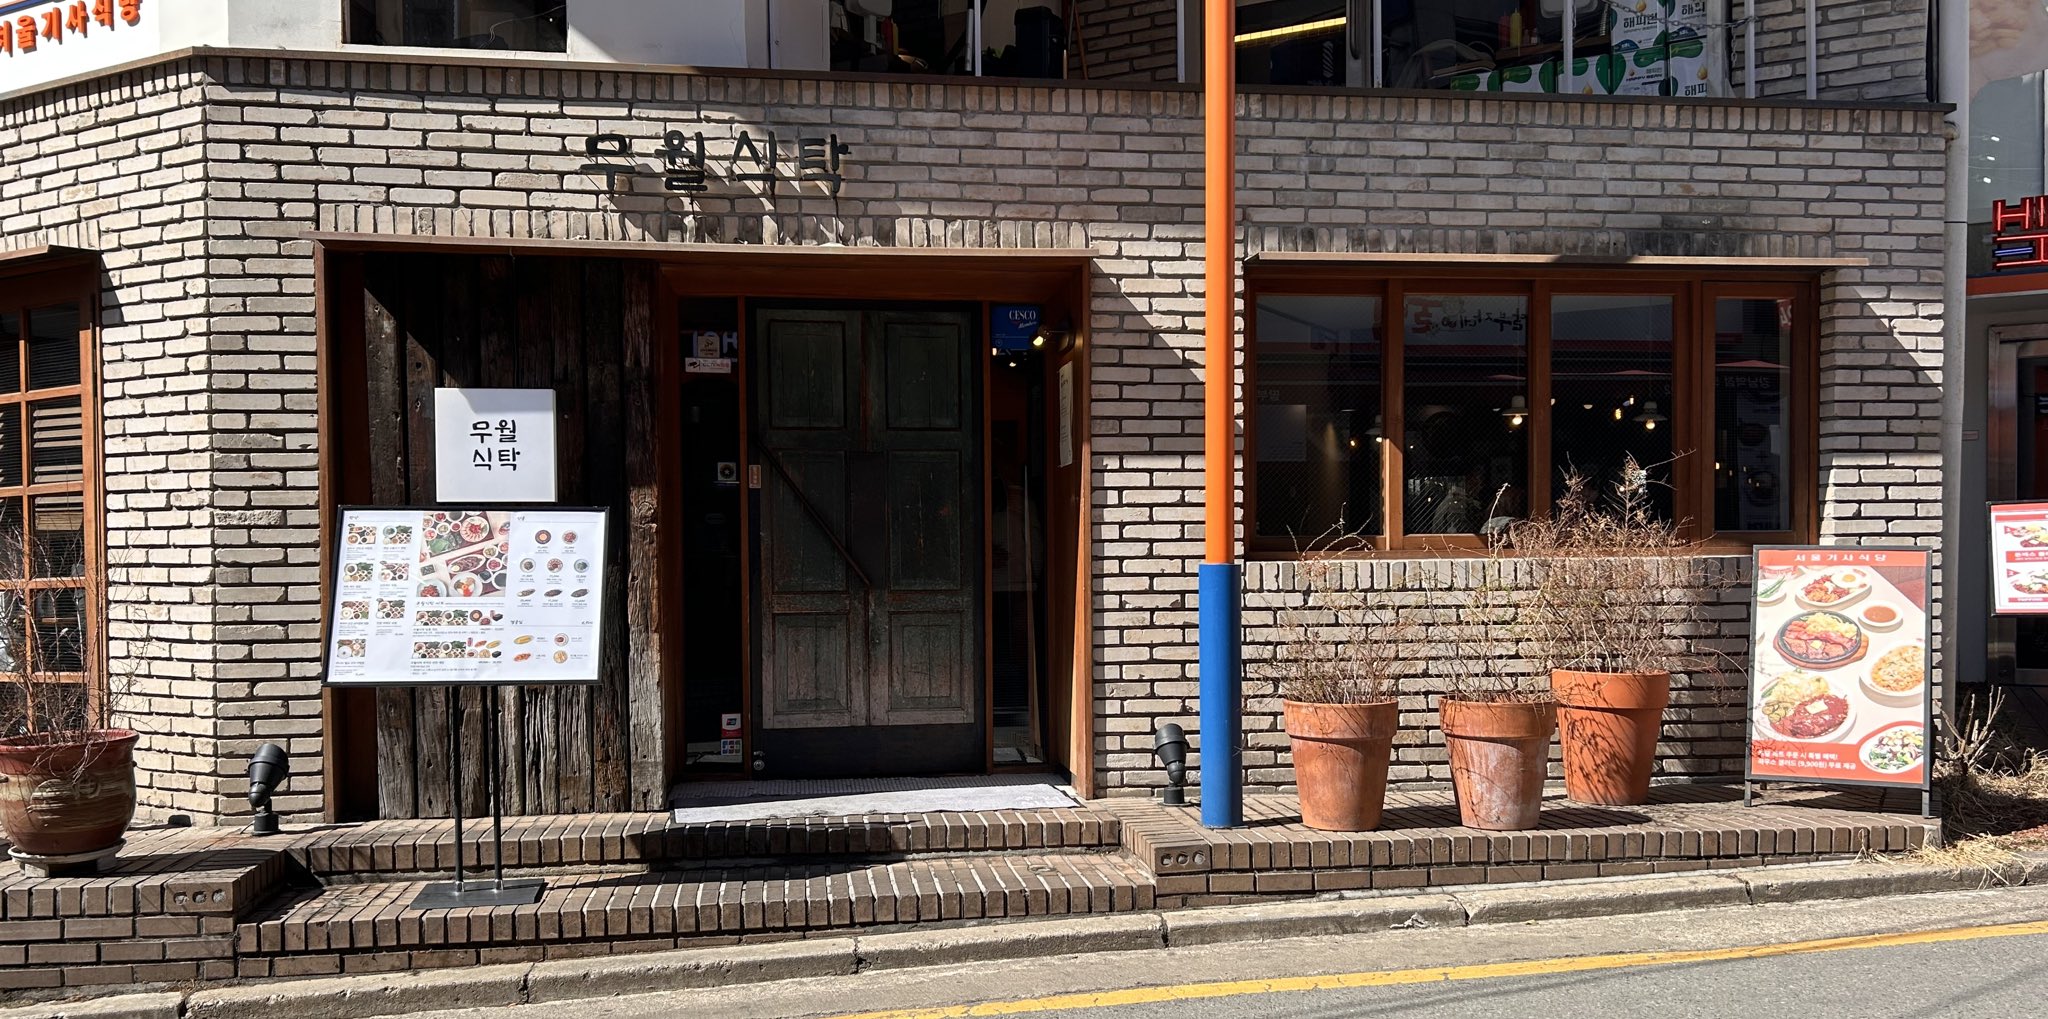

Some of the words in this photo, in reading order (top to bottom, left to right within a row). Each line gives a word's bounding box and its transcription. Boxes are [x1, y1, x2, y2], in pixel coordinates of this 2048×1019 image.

[580, 130, 850, 200] 무월식탁
[1009, 310, 1036, 320] CESCO
[470, 419, 517, 443] 무월
[473, 447, 520, 471] 식탁
[1786, 751, 1798, 759] 주문
[1808, 752, 1821, 760] 특별
[1828, 761, 1842, 769] 무료
[1843, 762, 1856, 770] 제공
